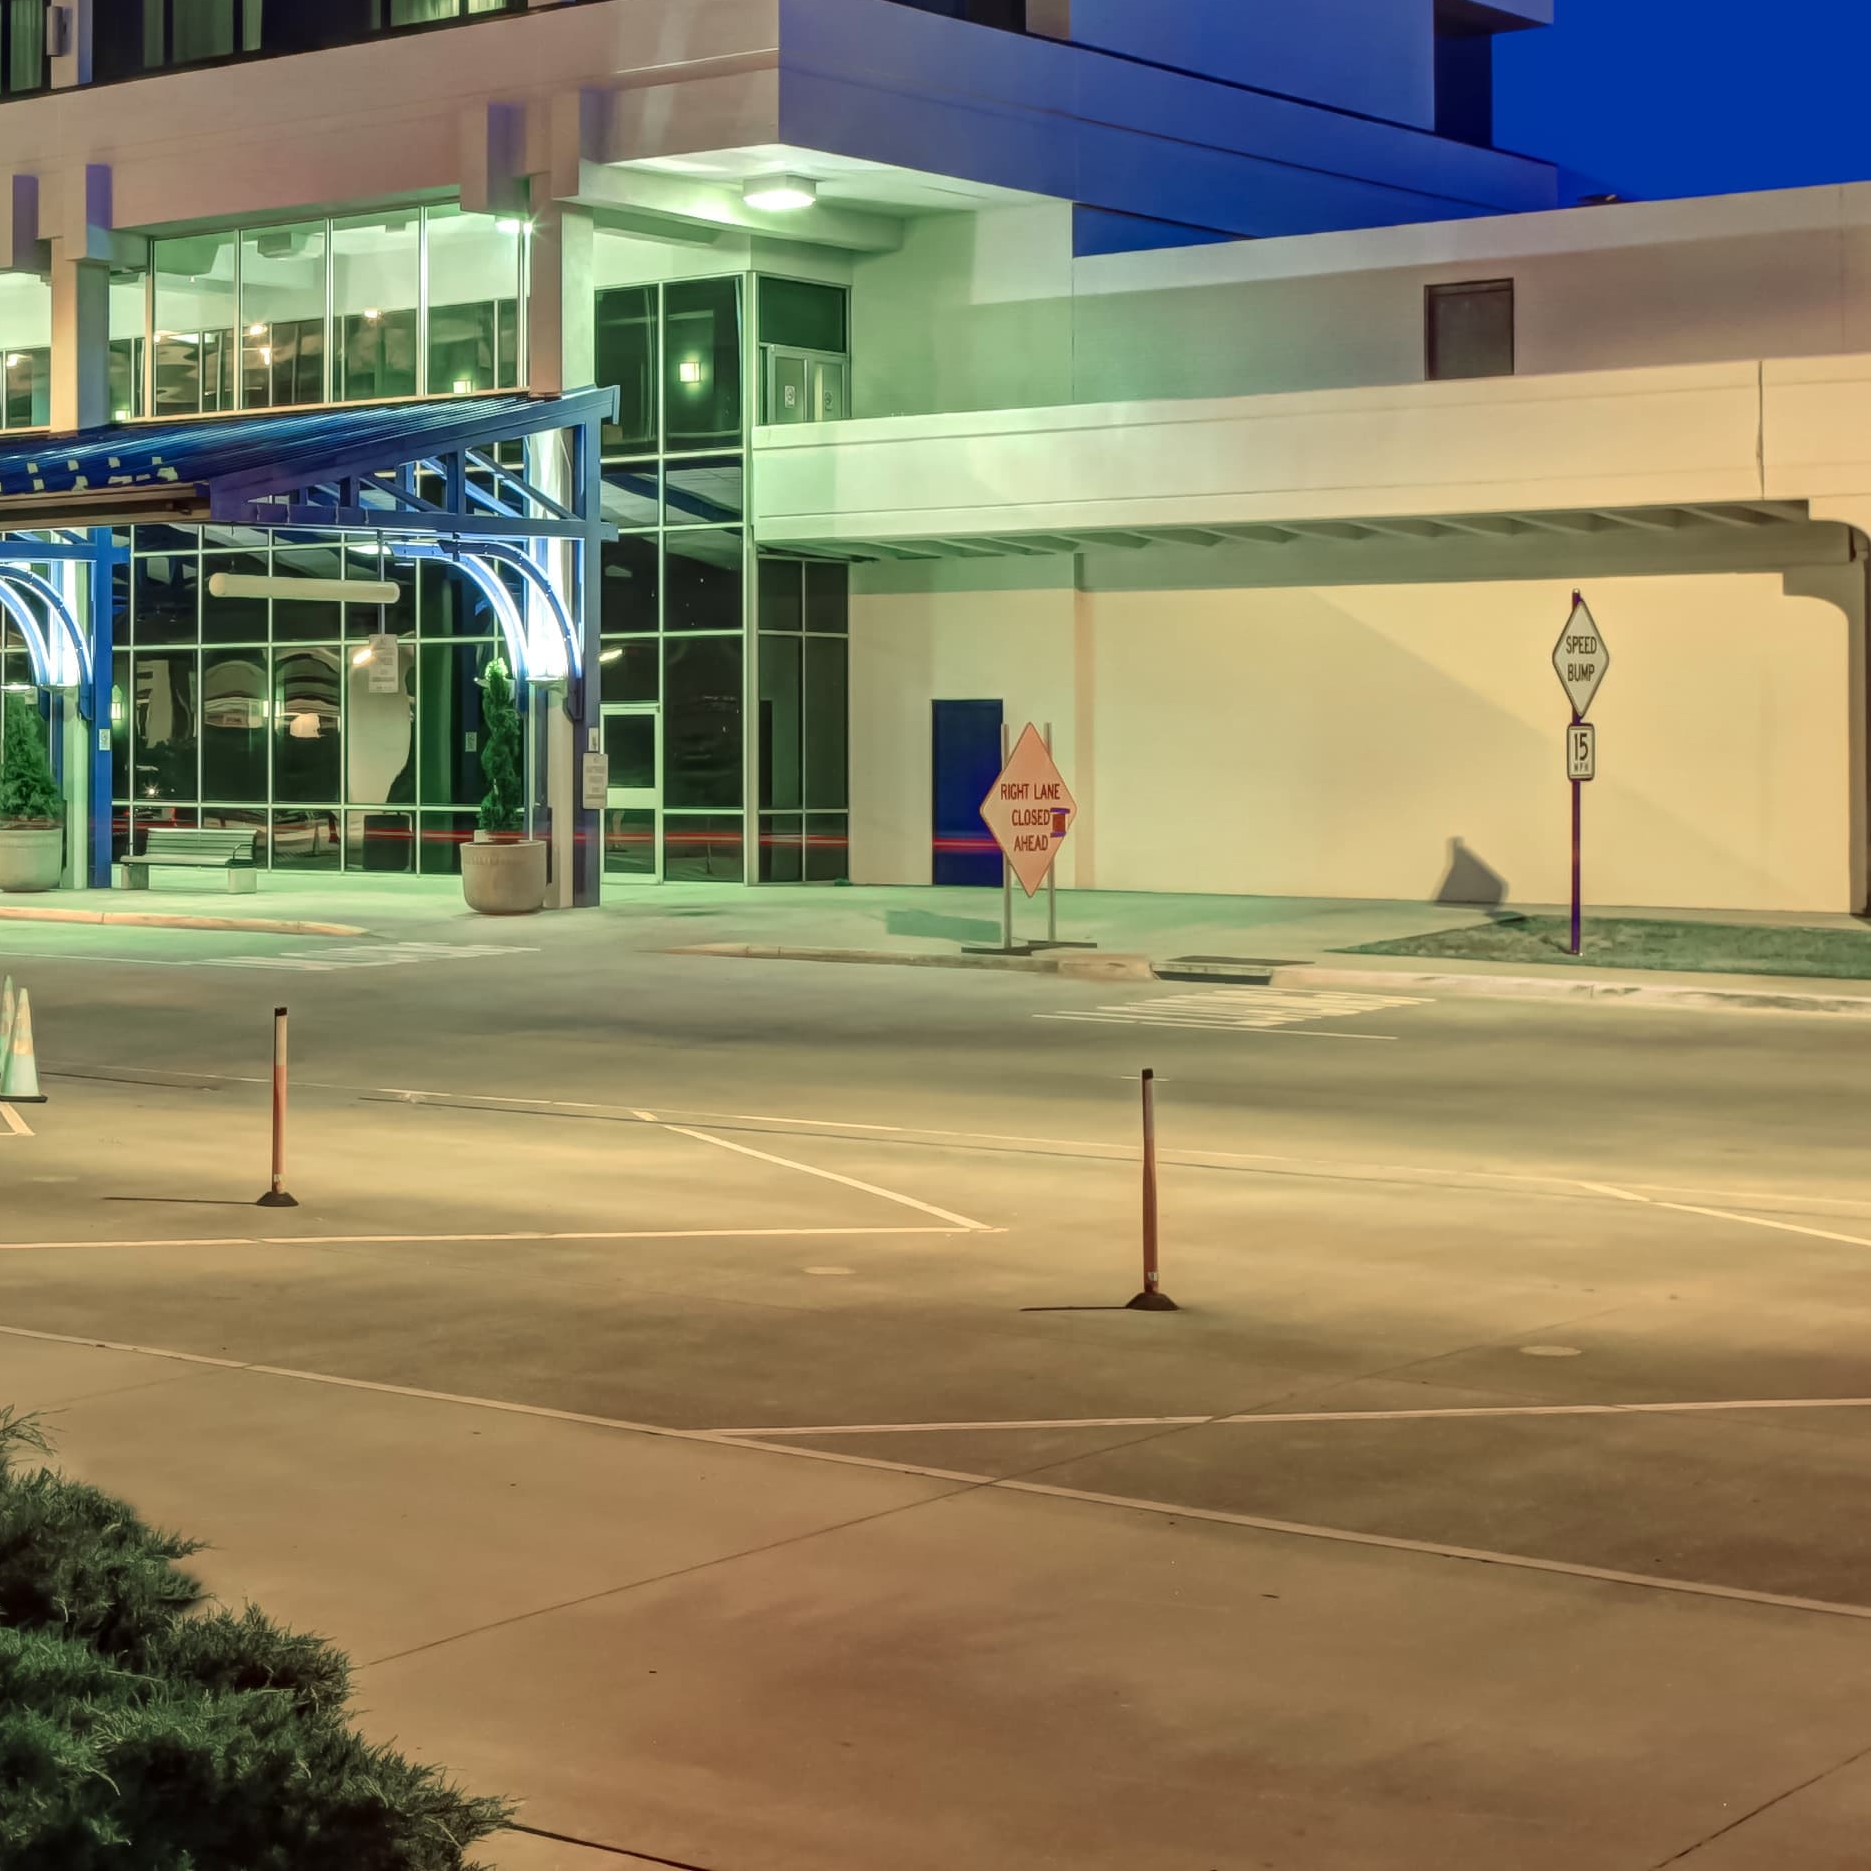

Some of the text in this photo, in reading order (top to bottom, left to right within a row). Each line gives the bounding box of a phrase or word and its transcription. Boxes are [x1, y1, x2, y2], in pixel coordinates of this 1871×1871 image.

[1566, 635, 1597, 654] SPEED
[1567, 662, 1595, 681] BUMP
[1574, 733, 1589, 761] 15
[1000, 783, 1061, 800] RIGHT LANE
[1011, 808, 1051, 826] CLOSED
[1013, 834, 1048, 851] AHEAD
